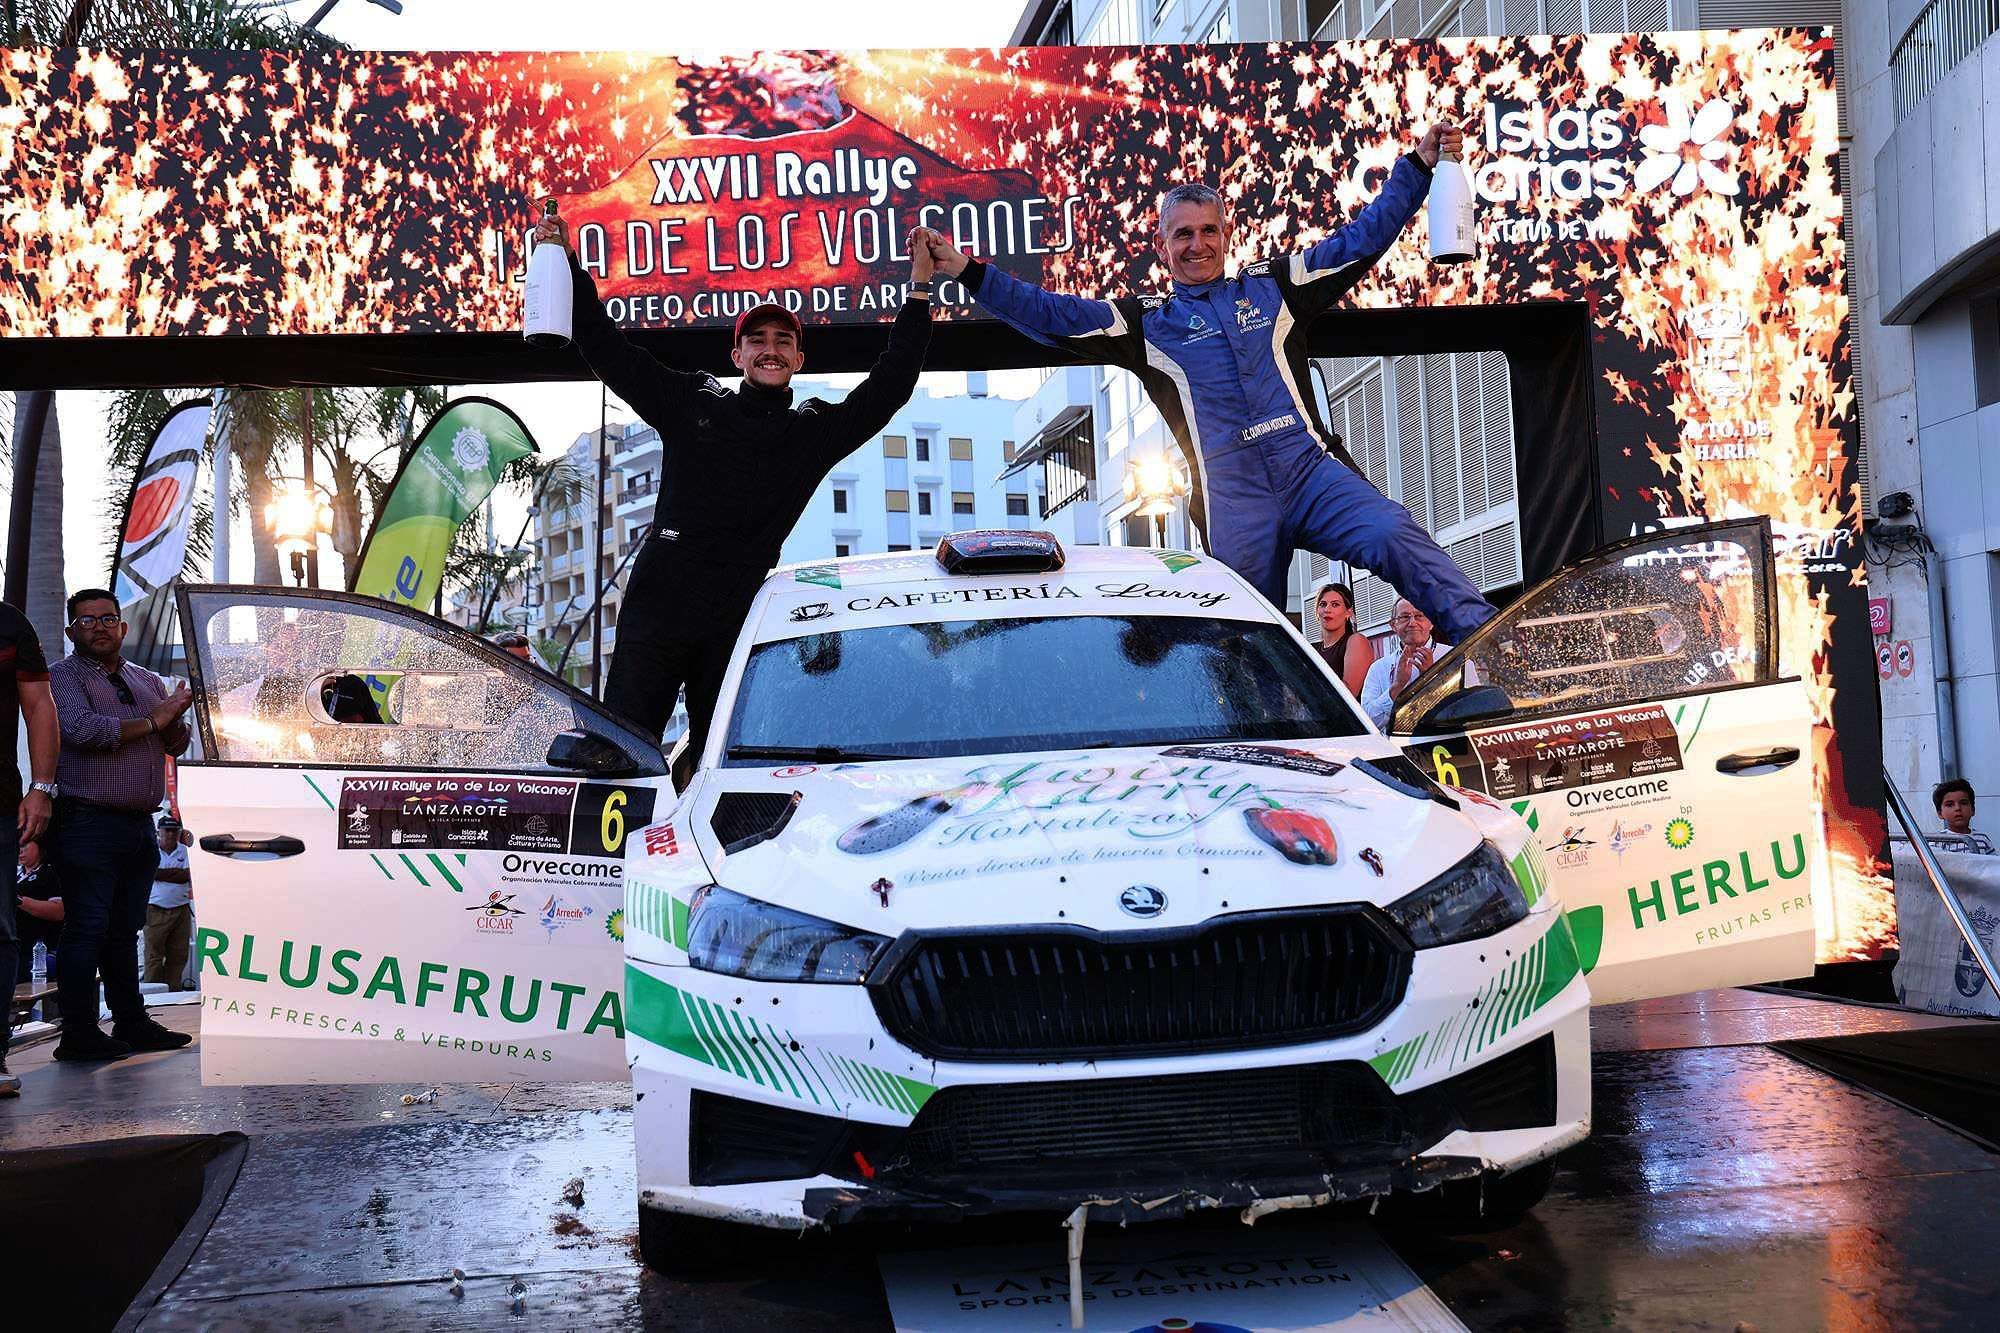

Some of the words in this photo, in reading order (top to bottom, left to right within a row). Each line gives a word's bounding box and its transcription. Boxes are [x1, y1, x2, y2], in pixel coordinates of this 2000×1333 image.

[1484, 101, 1624, 152] Islas
[651, 155, 759, 206] XXVII
[776, 149, 917, 207] Rallye
[1557, 219, 1582, 241] DE
[495, 222, 607, 283] ISA
[626, 218, 689, 277] DE
[706, 212, 800, 272] LOS
[692, 288, 802, 319] CIUDAD
[812, 286, 848, 312] DE
[847, 582, 1083, 611] CAFETERÍA
[1095, 581, 1231, 608] Larry
[1475, 732, 1515, 748] XXVII
[1516, 727, 1550, 741] Rallye
[1551, 724, 1571, 735] Isla
[1575, 721, 1591, 731] de
[1594, 717, 1613, 727] Los
[1615, 709, 1665, 724] Volcanes
[1536, 737, 1626, 761] LANZAROTE
[1432, 745, 1460, 788] 6
[344, 780, 389, 791] XXVII
[392, 780, 432, 793] Rallye
[436, 780, 458, 791] Isla
[464, 781, 483, 792] de
[488, 782, 510, 792] Los
[517, 782, 574, 796] Volcanes
[1566, 779, 1669, 808] Orvecame
[403, 804, 508, 817] LANZAROTE
[601, 790, 628, 852] 6
[1679, 804, 1693, 815] bp
[447, 834, 477, 842] Canarias
[510, 833, 534, 841] Centros
[535, 834, 543, 842] de
[938, 808, 1196, 846] Hortalizas
[536, 841, 562, 849] Turismo
[976, 855, 1051, 873] directa
[1060, 848, 1085, 864] de
[1093, 844, 1164, 860] huerta
[1556, 850, 1589, 866] CICAR
[502, 853, 623, 879] Orvecame
[1627, 833, 1806, 930] HERLU
[476, 916, 513, 930] CICAR
[555, 907, 583, 919] Arrecife
[1695, 908, 1771, 945] FRUTAS
[199, 927, 625, 1039] RLUSAFRUTA
[270, 1007, 380, 1038] FRESCAS
[394, 1027, 406, 1042] &
[421, 1031, 553, 1062] VERDURAS
[951, 1255, 1339, 1296] LANZAROTE
[1111, 1272, 1352, 1299] DESTINATION
